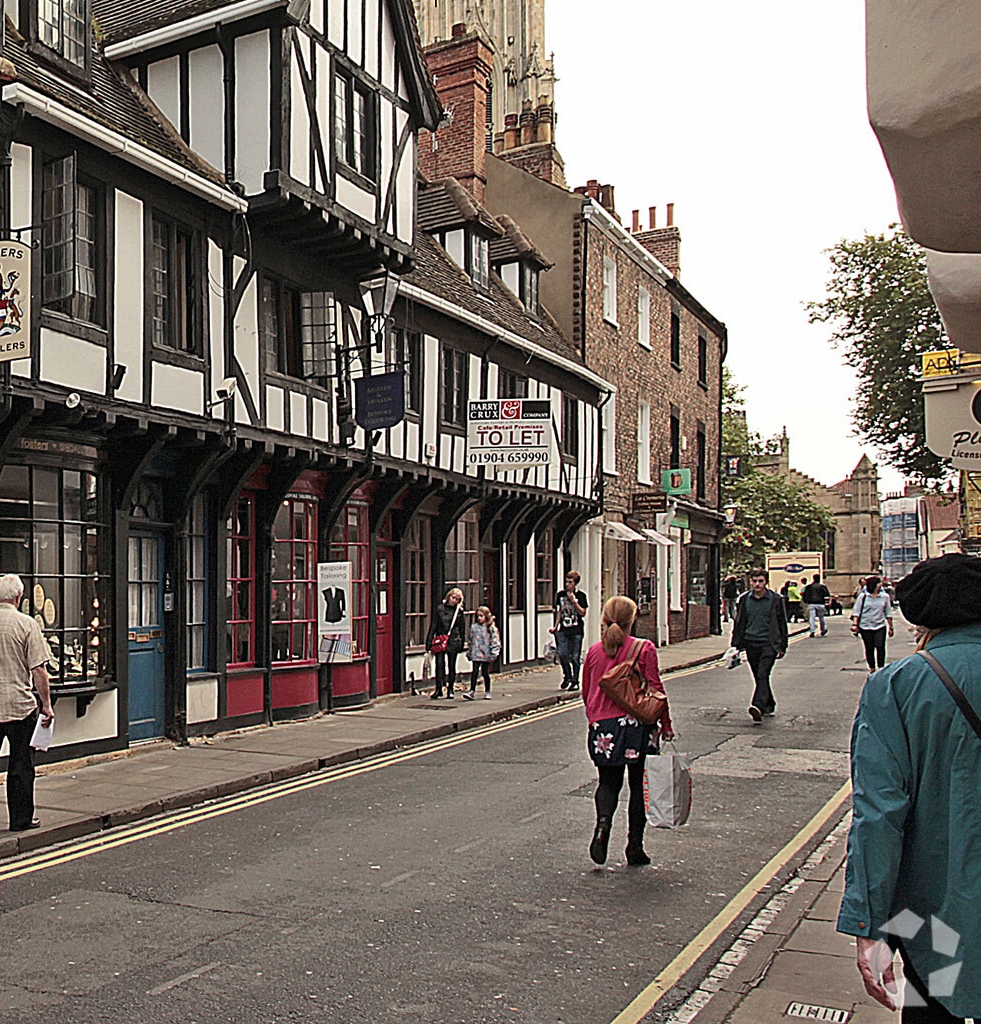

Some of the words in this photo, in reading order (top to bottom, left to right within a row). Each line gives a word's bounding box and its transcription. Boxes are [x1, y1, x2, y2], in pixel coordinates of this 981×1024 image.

[470, 403, 498, 411] BARRY
[470, 411, 498, 419] CRUX
[477, 430, 503, 445] TO
[509, 430, 545, 445] LET
[953, 431, 981, 448] Pl
[20, 437, 50, 451] fosters
[469, 453, 504, 463] 01904
[507, 452, 549, 463] 659990
[951, 449, 981, 459] Licens
[320, 565, 348, 573] Bespoke
